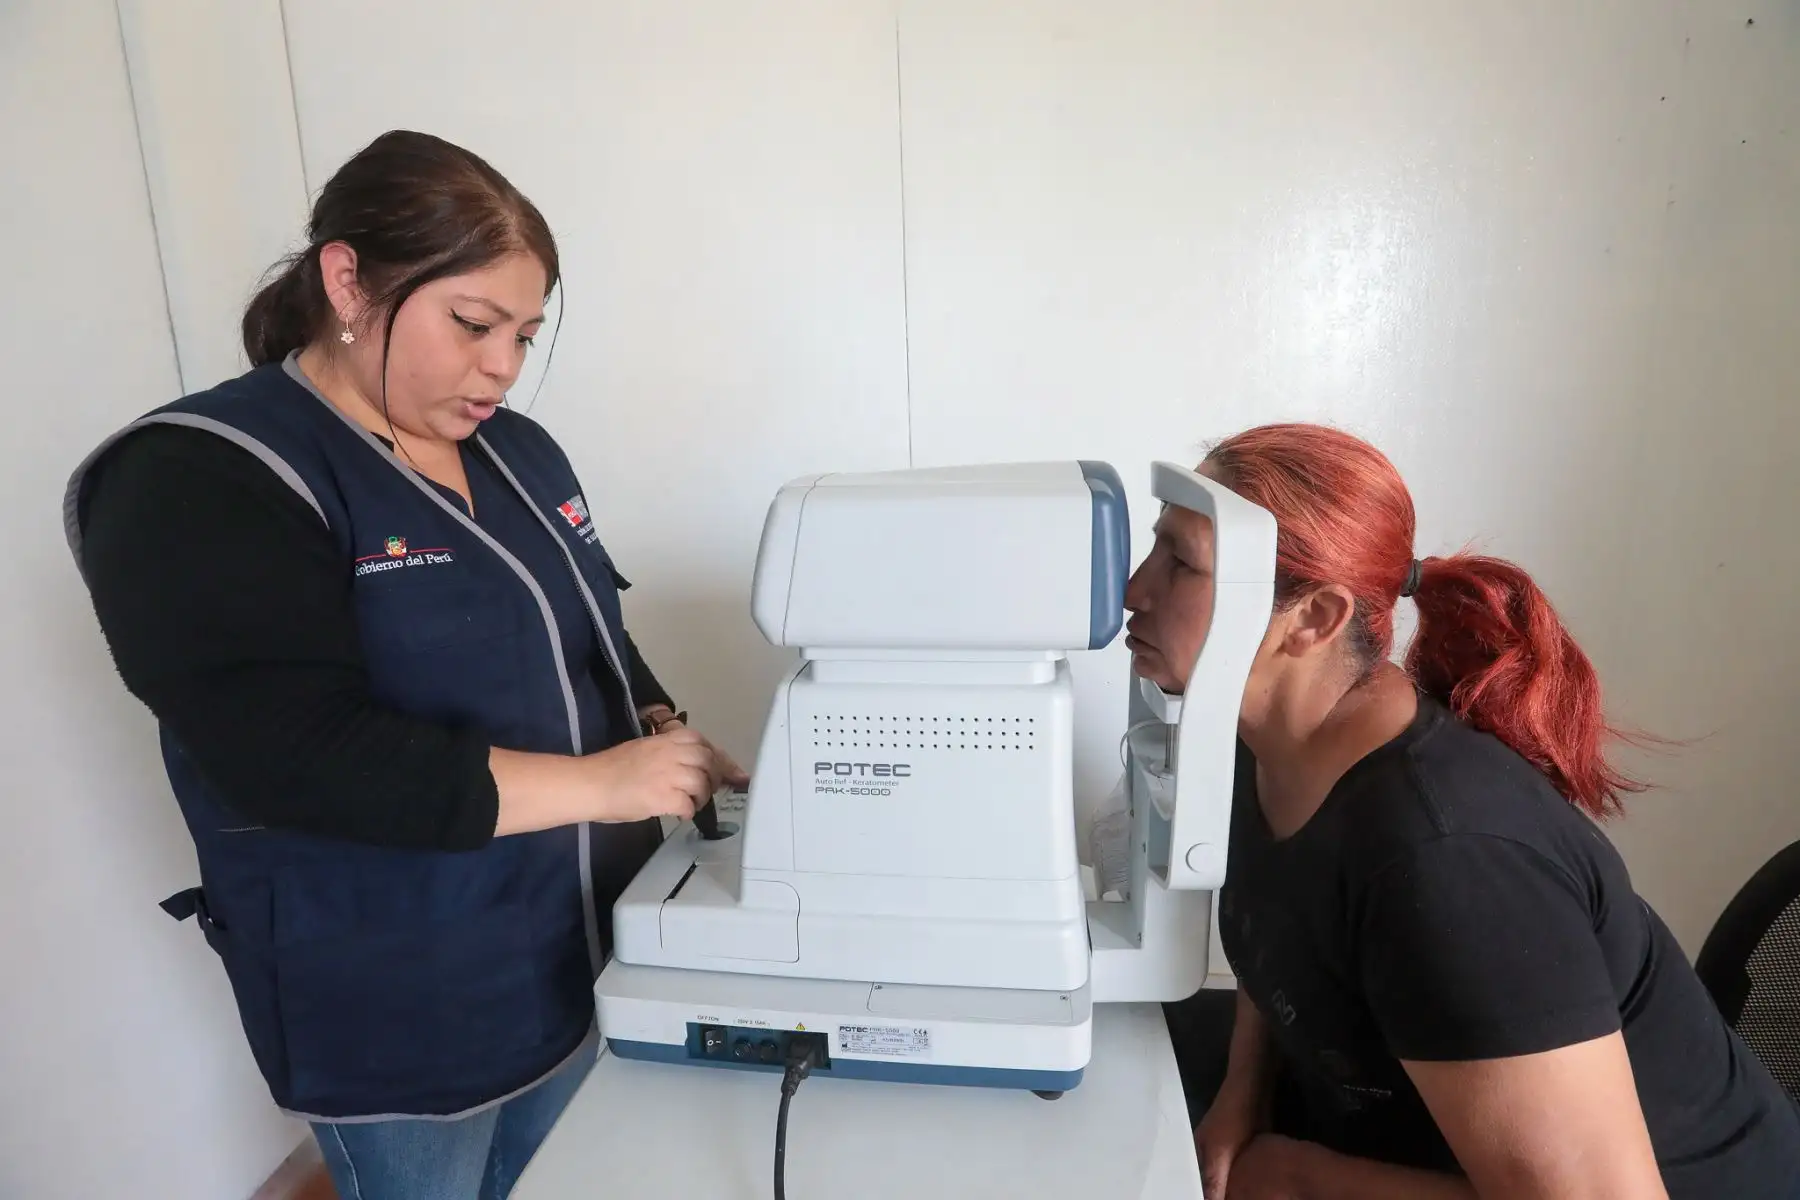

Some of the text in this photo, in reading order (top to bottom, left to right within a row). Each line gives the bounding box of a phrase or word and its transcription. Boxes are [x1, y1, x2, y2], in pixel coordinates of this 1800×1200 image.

[406, 555, 425, 567] del
[425, 552, 453, 564] Perú
[814, 762, 911, 777] POTEC
[852, 779, 899, 787] Keratometer
